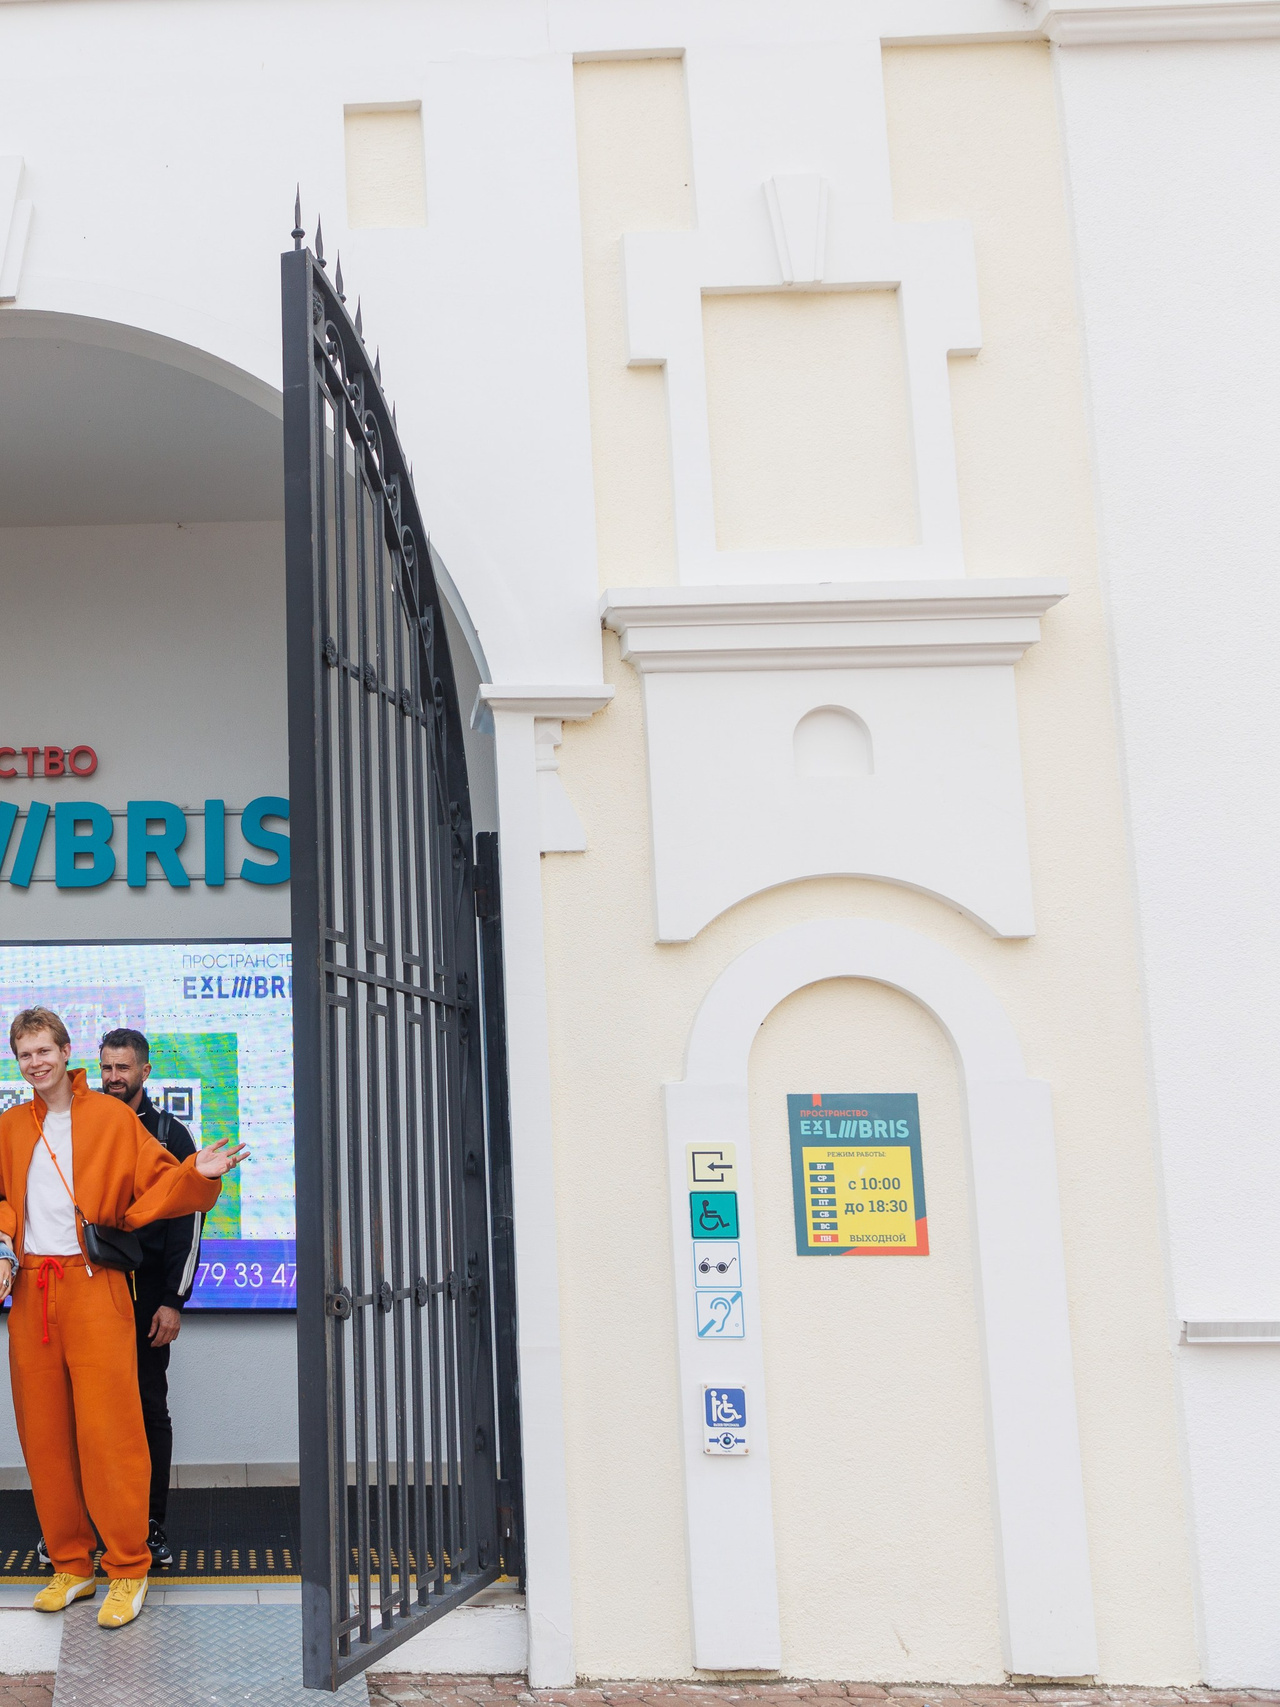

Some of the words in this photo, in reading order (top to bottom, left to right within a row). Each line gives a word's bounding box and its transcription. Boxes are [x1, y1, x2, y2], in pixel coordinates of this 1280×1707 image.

[848, 1180, 857, 1190] с
[860, 1177, 901, 1190] 10:00
[844, 1202, 865, 1215] до
[868, 1199, 908, 1213] 18:30
[849, 1233, 907, 1243] ВЫХОДНОЙ
[198, 1263, 226, 1287] 79
[234, 1262, 263, 1287] 33
[271, 1263, 297, 1287] 47
